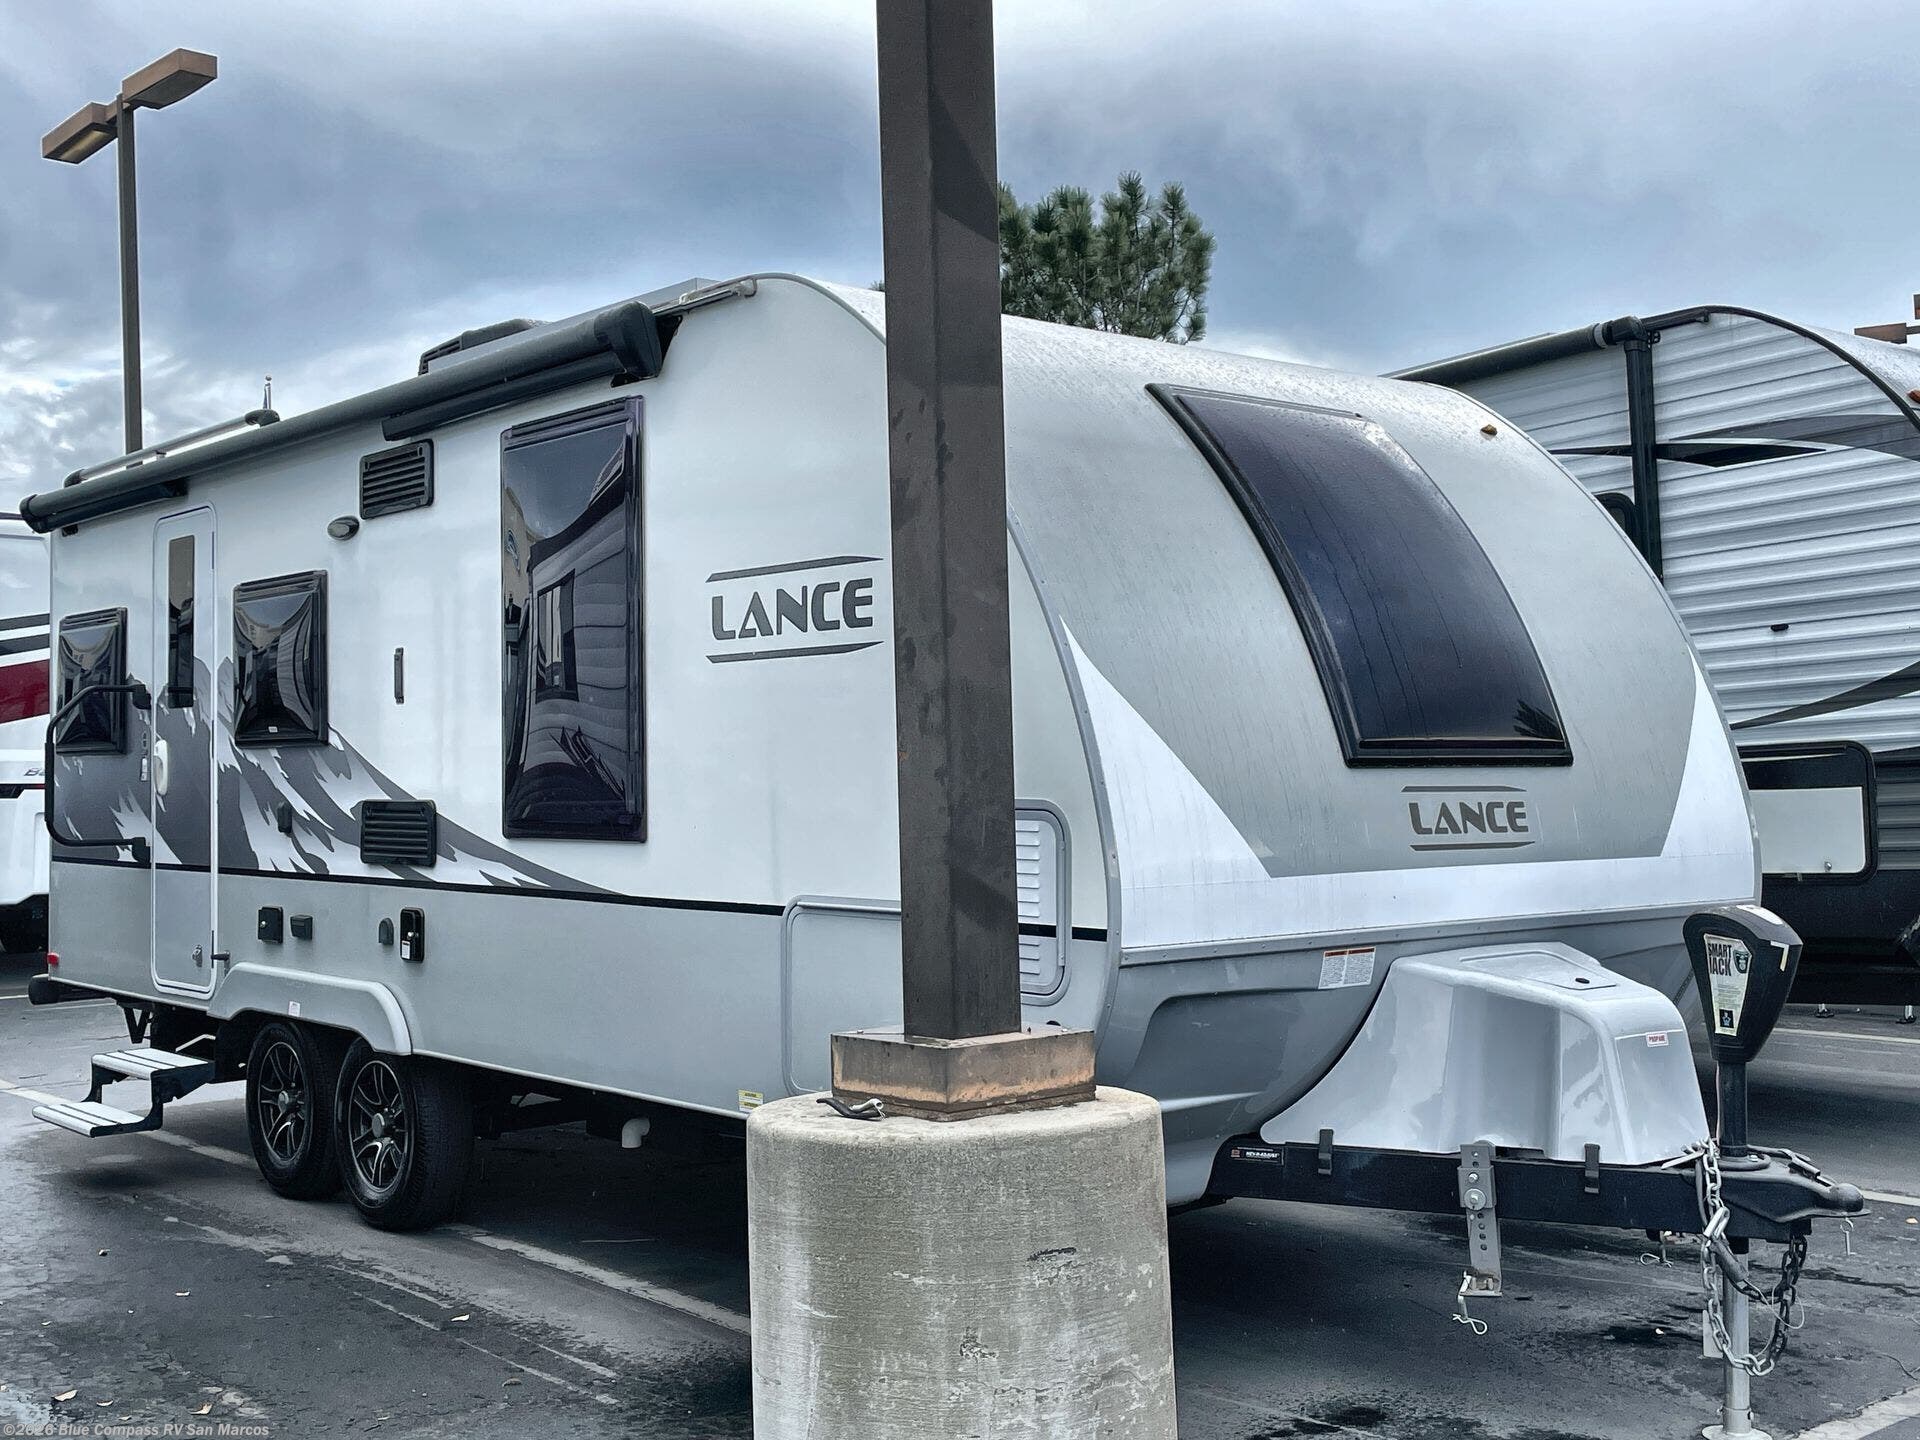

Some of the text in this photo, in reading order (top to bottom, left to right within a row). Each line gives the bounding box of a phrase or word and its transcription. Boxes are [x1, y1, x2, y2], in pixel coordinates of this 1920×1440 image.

[711, 577, 874, 641] LANCE
[1408, 801, 1529, 835] LANCE
[1707, 943, 1732, 959] SMART
